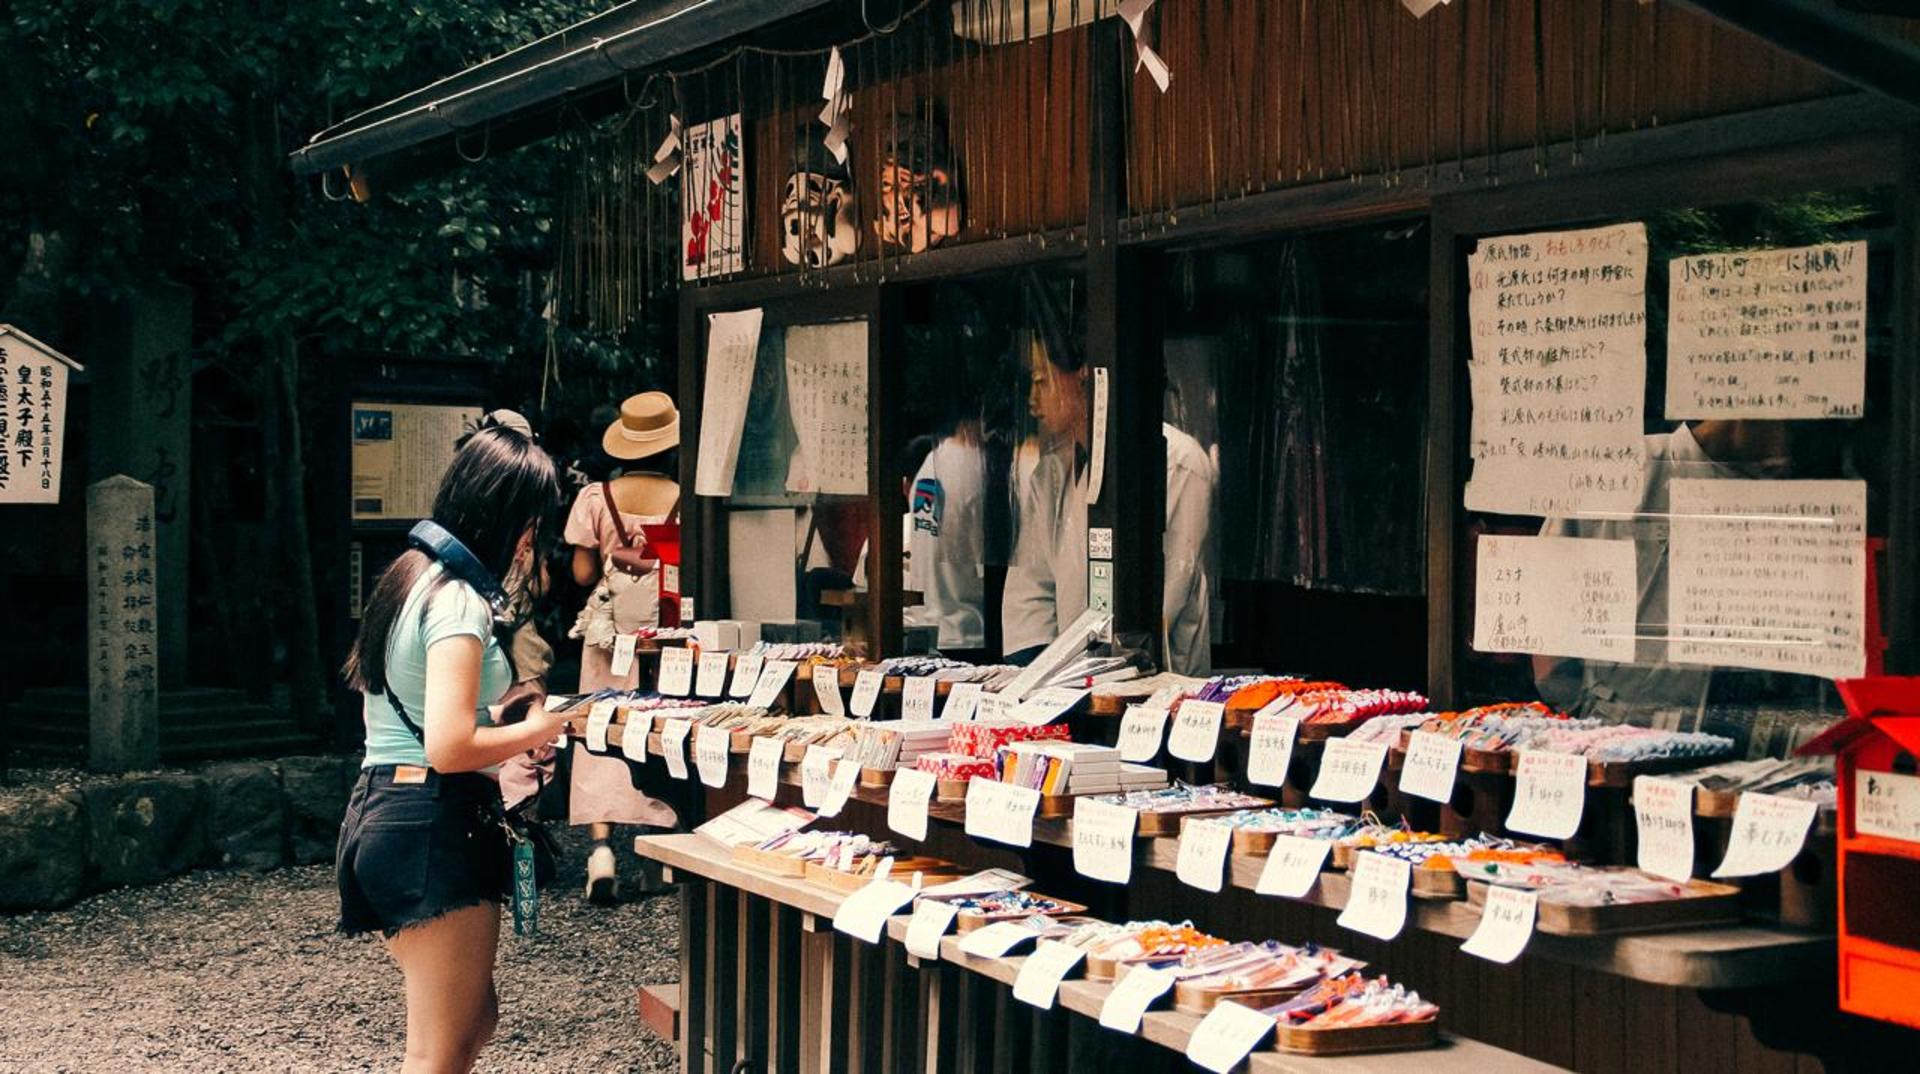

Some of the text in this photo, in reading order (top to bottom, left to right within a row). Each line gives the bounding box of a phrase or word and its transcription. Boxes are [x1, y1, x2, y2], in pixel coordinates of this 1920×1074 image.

[15, 364, 34, 468] 皇太子殿下
[39, 365, 53, 490] 昭和五十五年三月十八日
